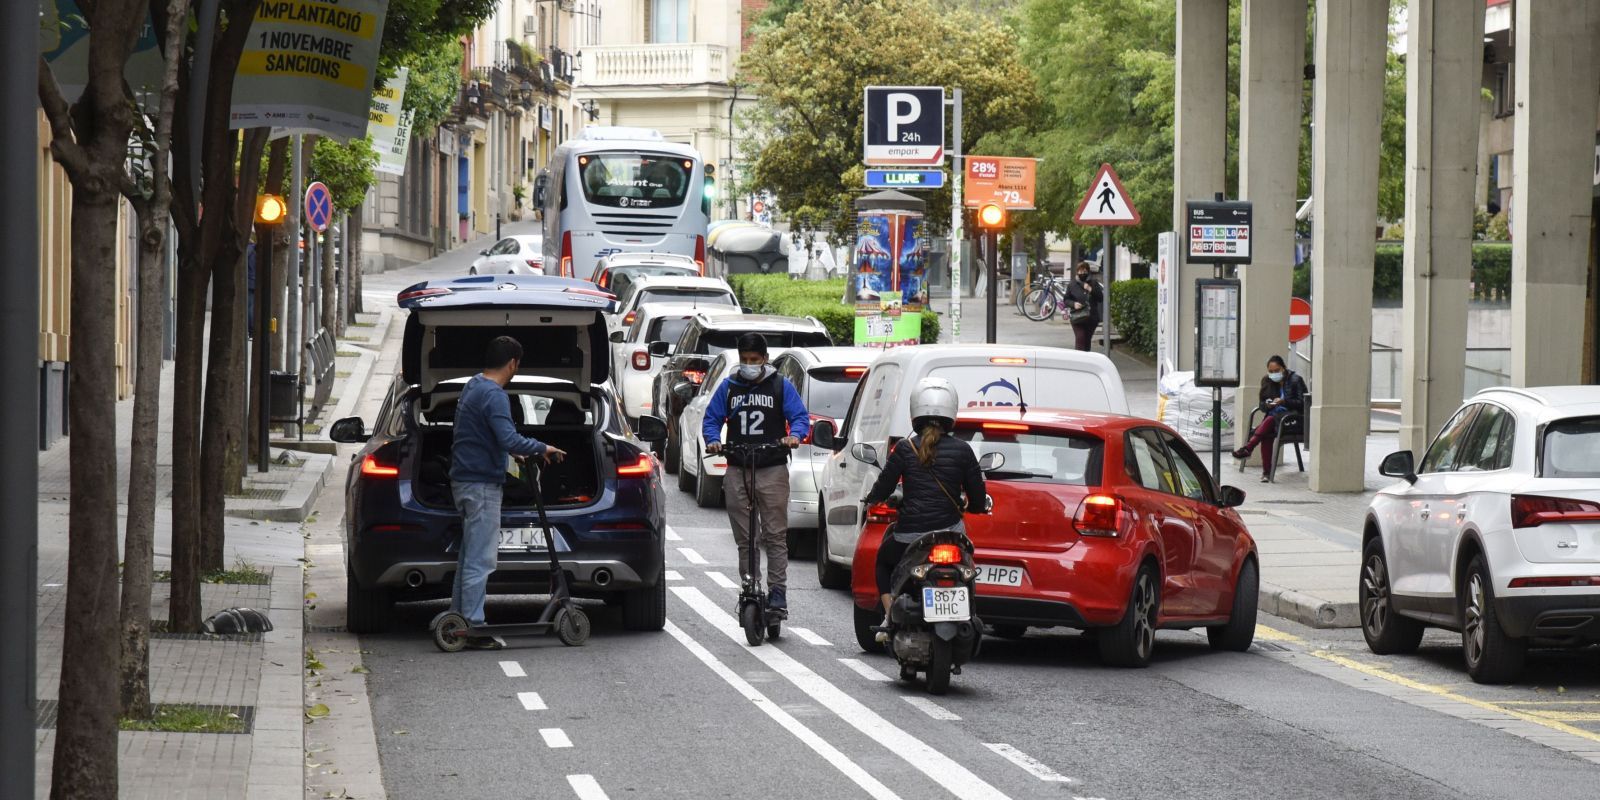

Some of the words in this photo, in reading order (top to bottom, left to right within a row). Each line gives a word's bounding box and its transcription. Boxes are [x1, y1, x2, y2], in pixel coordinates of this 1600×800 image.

[259, 2, 362, 33] IMPLANTACIÓ
[260, 31, 267, 49] 1
[270, 31, 353, 61] NOVEMBRE
[265, 54, 341, 79] SANCIONS
[887, 92, 921, 142] P
[902, 132, 921, 142] 24h
[888, 147, 920, 156] empark
[972, 162, 997, 173] 28%
[606, 179, 649, 187] Avant
[731, 393, 774, 409] ORLANDO
[738, 410, 765, 435] 12
[987, 567, 1018, 584] HPG
[934, 590, 966, 602] 8673
[935, 603, 958, 615] HHC
